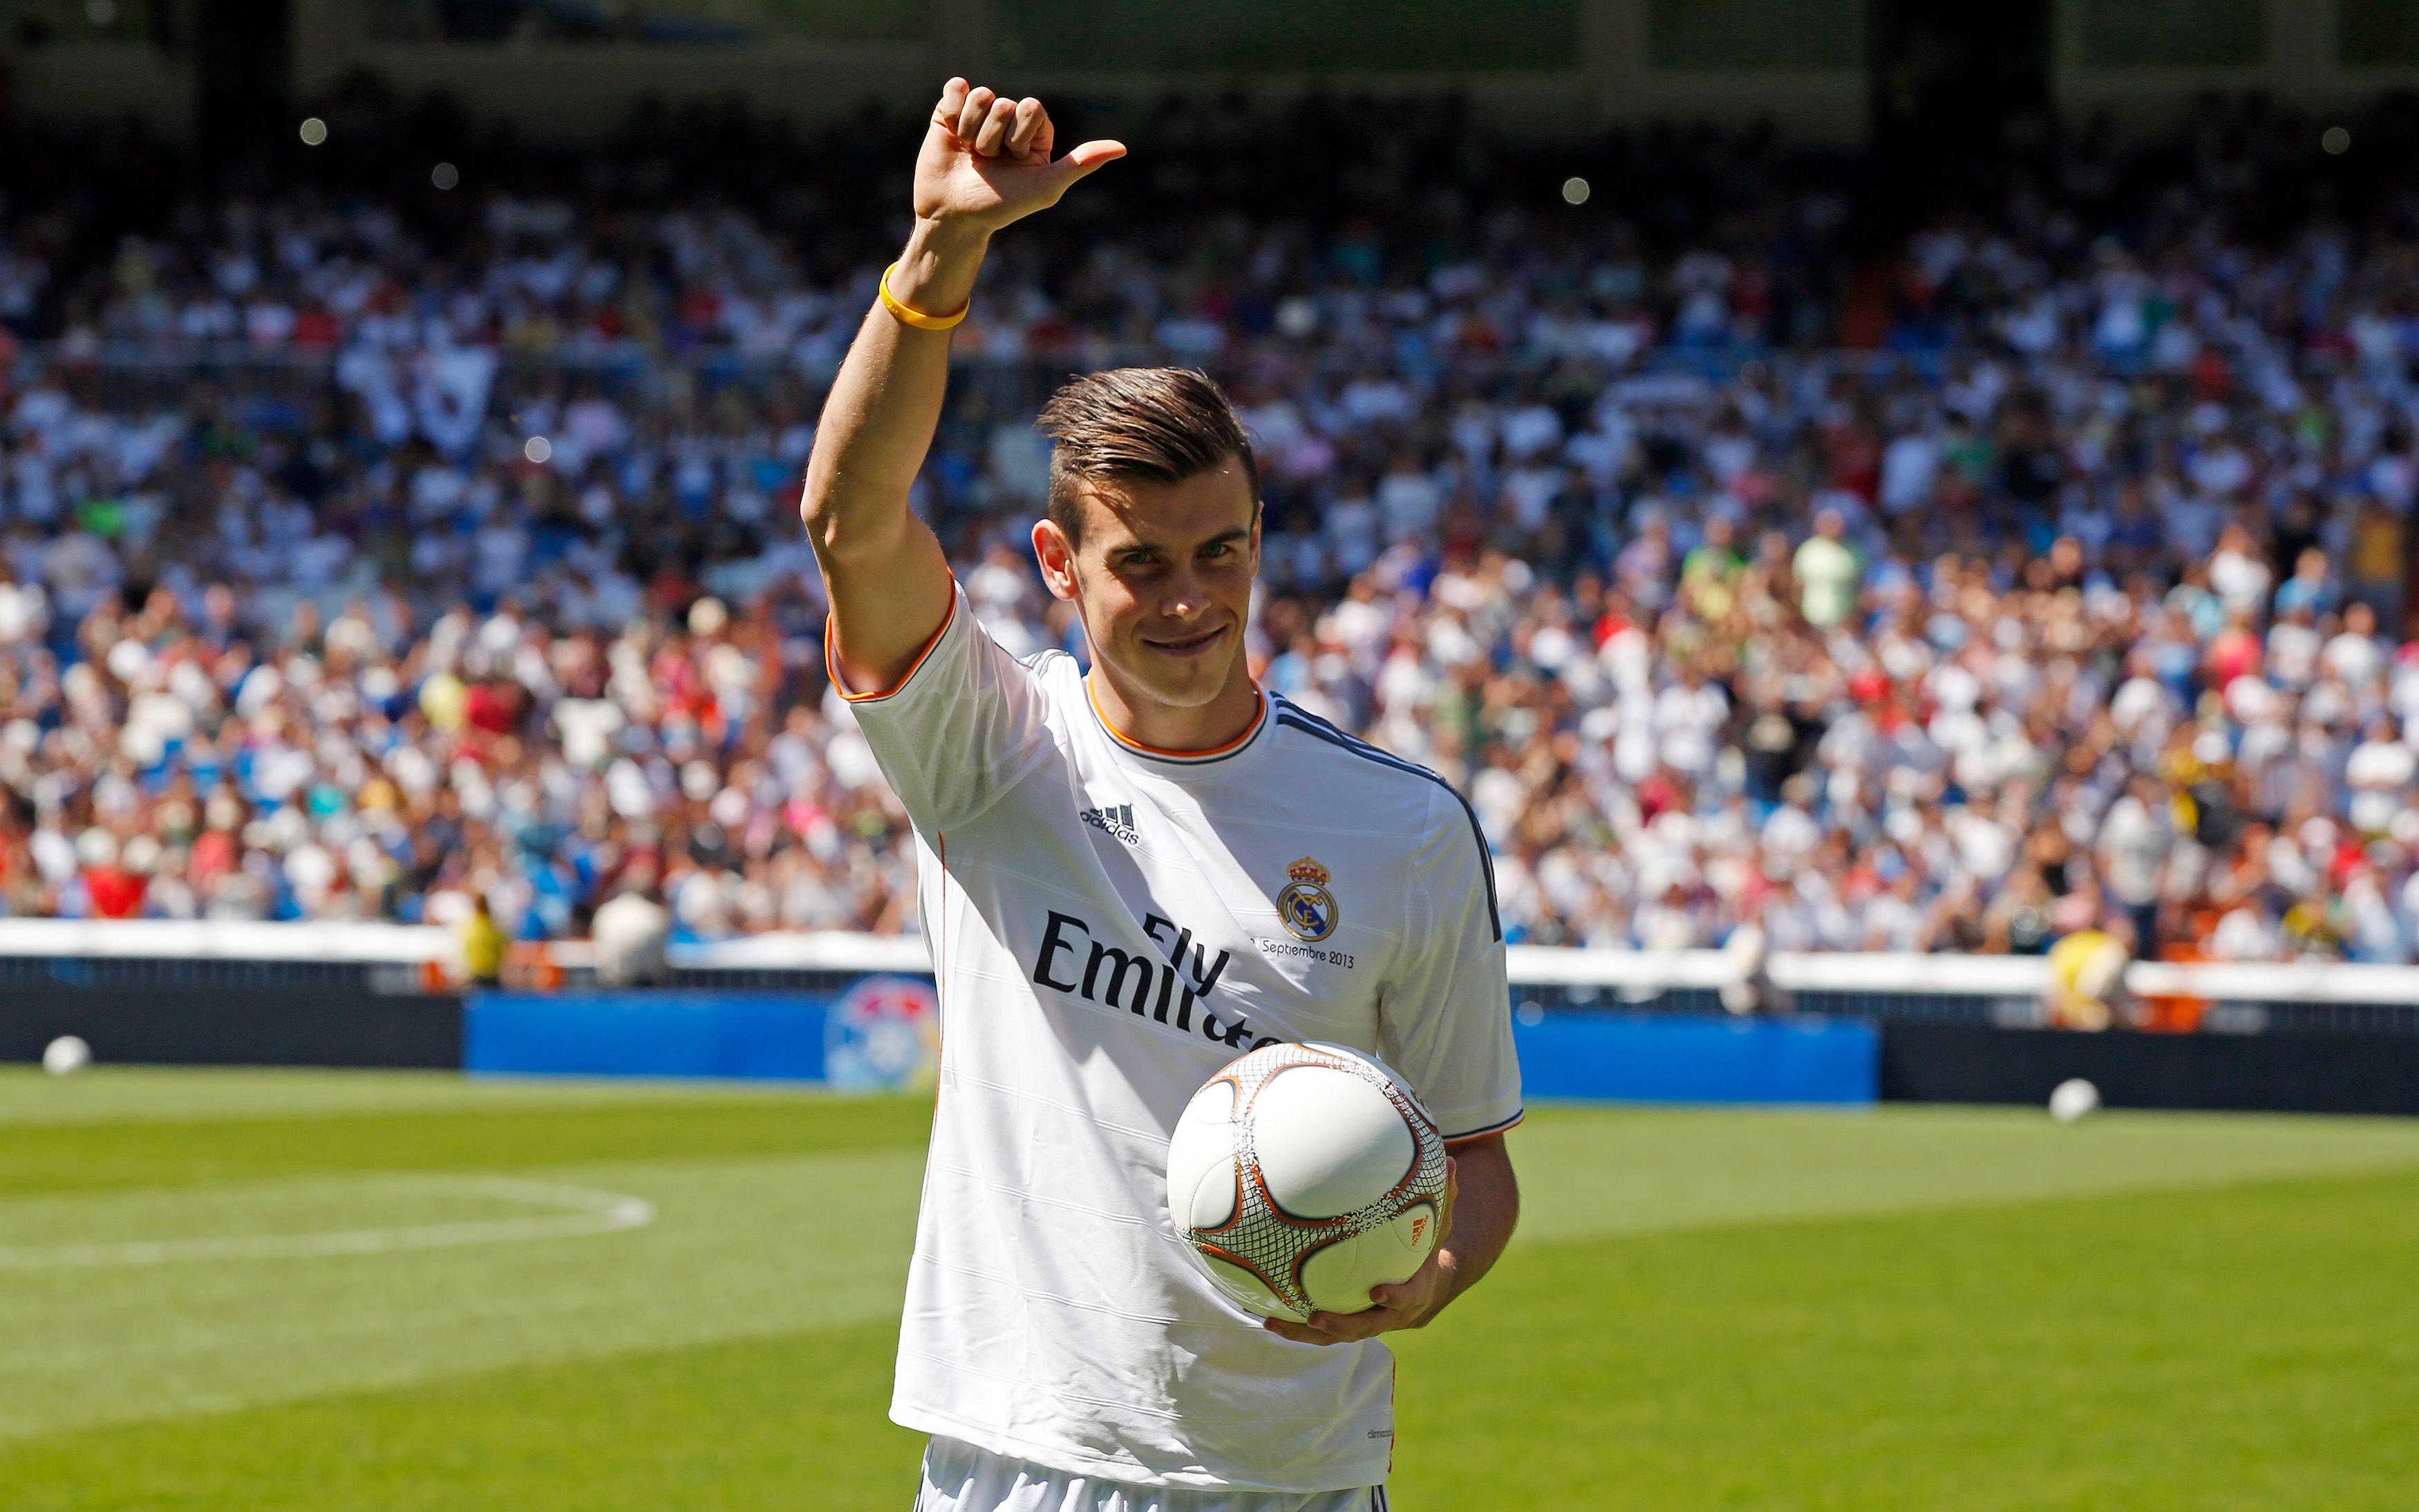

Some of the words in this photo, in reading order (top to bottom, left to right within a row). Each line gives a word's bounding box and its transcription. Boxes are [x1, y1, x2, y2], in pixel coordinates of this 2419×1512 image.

[1080, 811, 1139, 845] adidas
[1033, 909, 1284, 1053] Emirat
[1142, 911, 1230, 998] Fly
[1262, 940, 1326, 961] Septiembre
[1328, 950, 1355, 969] 2013
